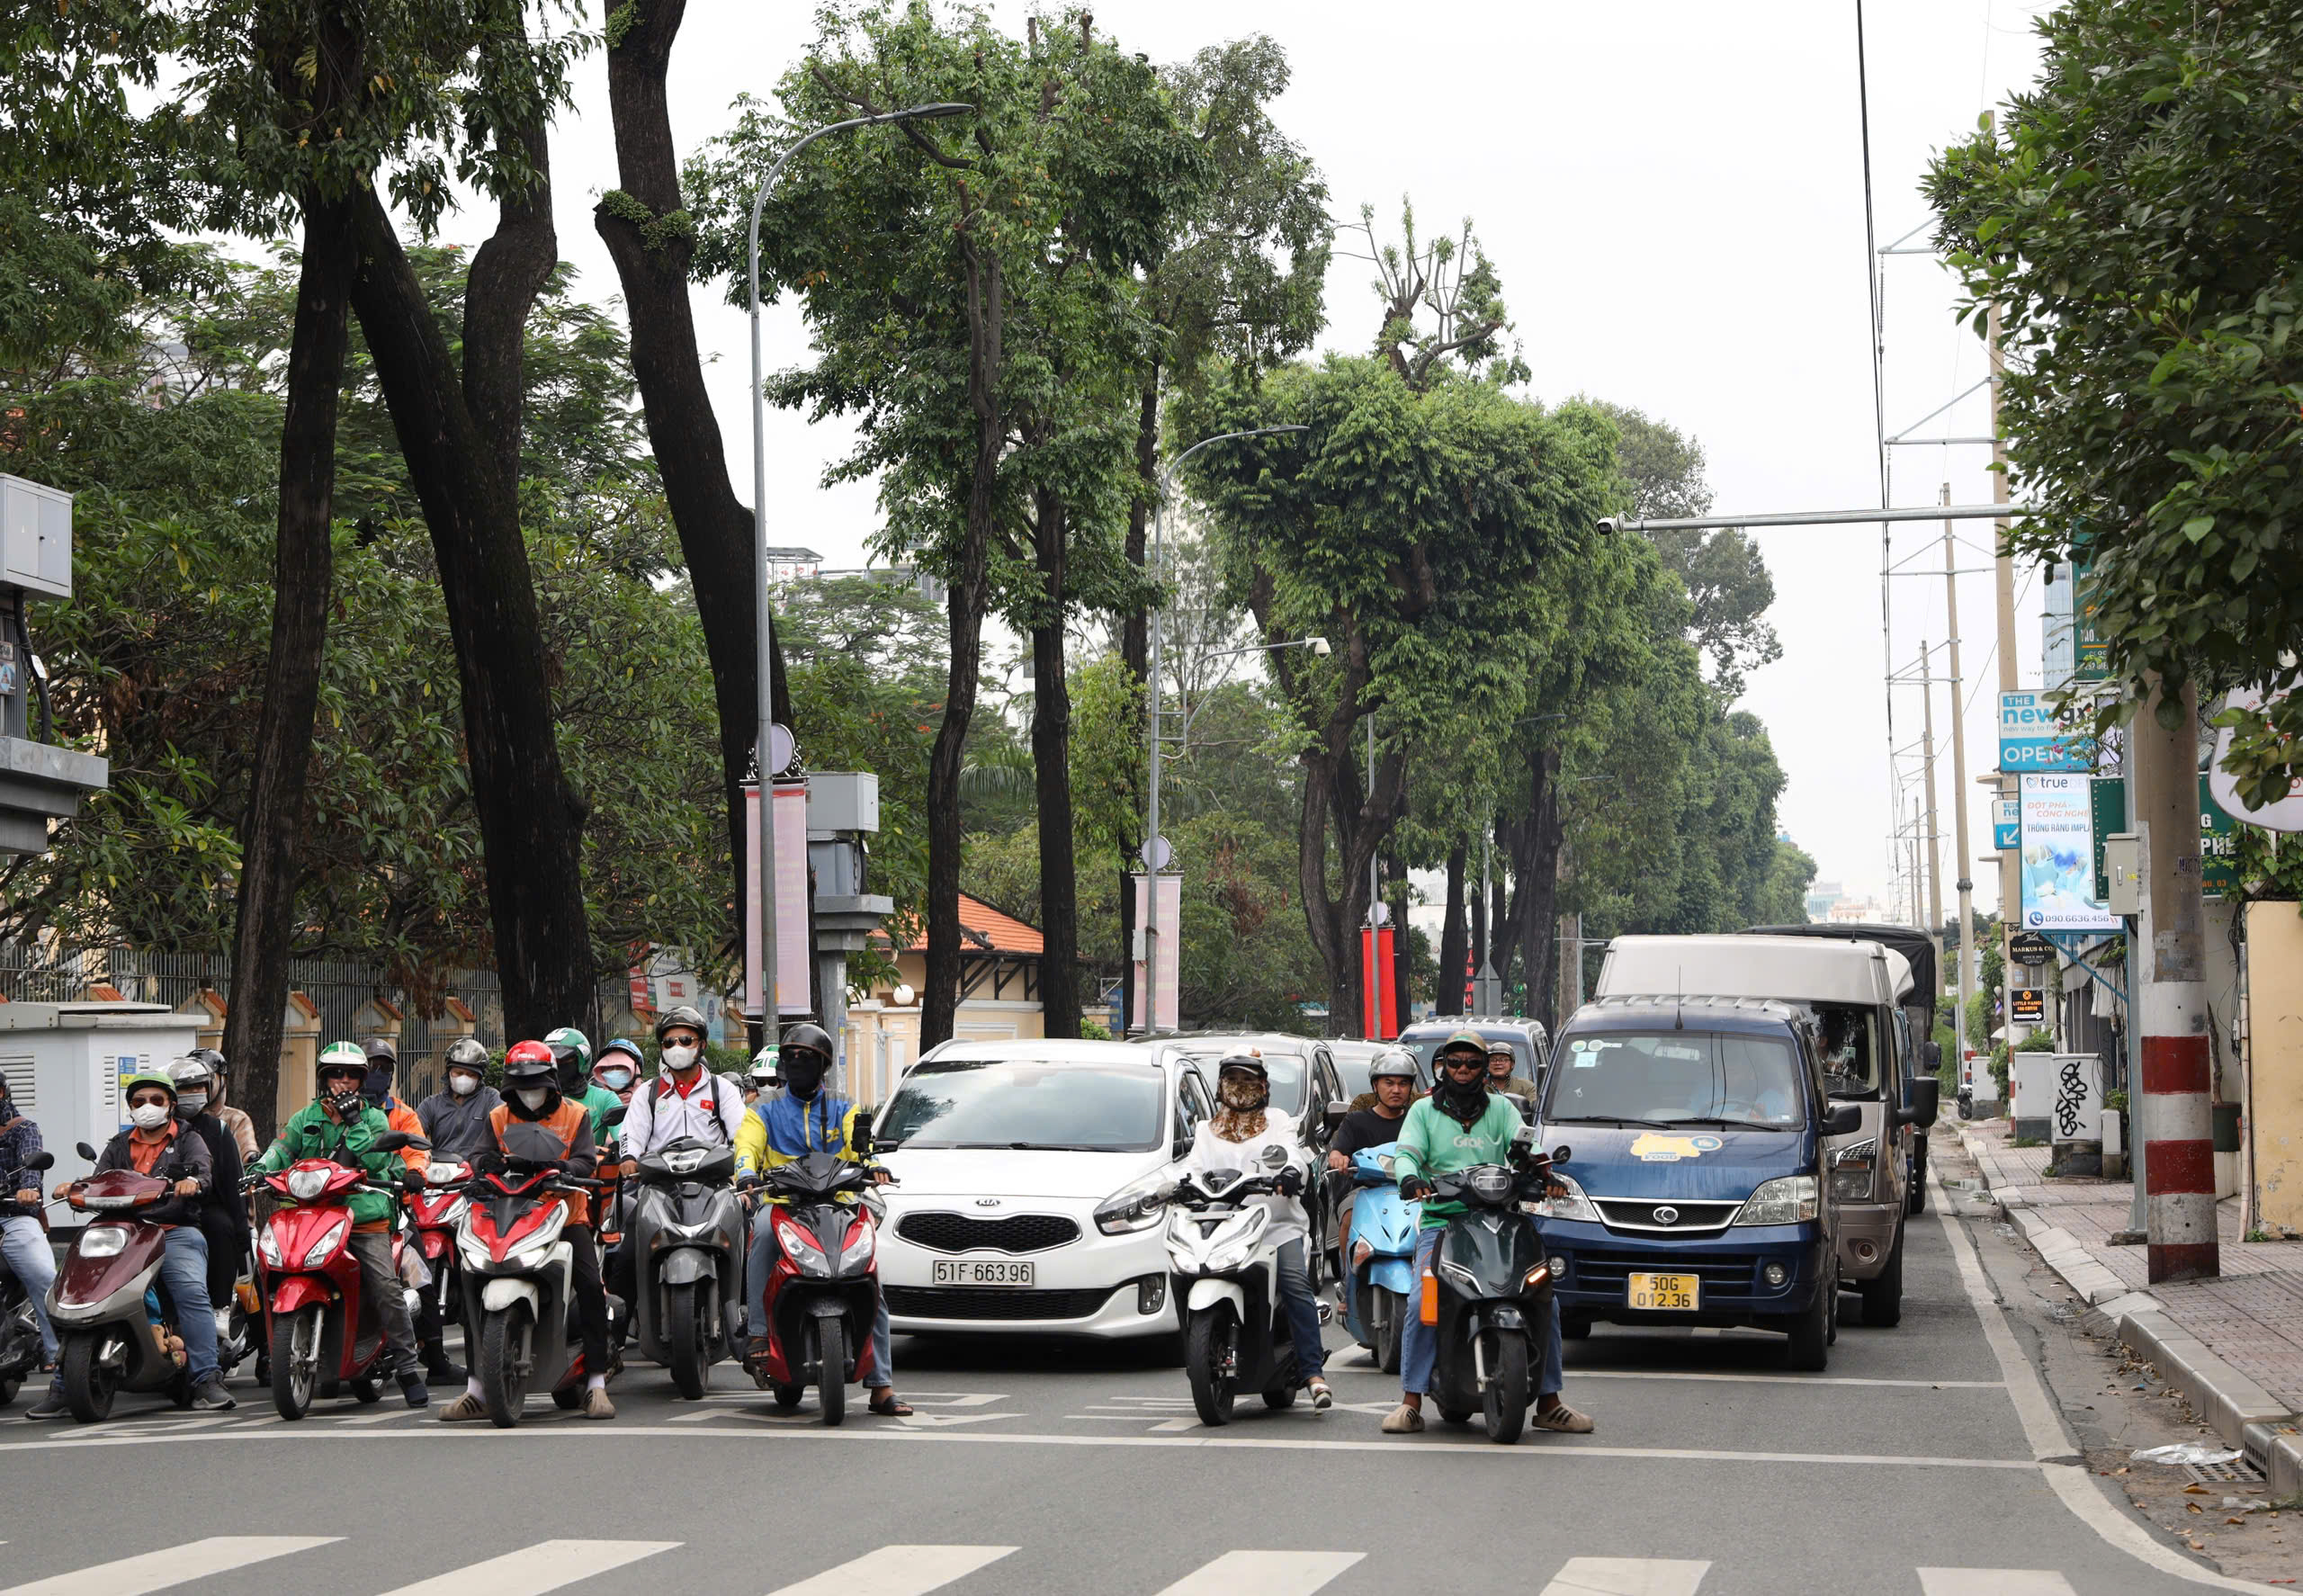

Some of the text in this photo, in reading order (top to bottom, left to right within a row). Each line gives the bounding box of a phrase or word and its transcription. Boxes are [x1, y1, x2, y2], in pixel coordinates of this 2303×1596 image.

[2008, 696, 2030, 705] THE
[937, 1262, 1029, 1282] 51F-663.96
[1650, 1277, 1679, 1291] 50G
[1636, 1292, 1690, 1307] 012.36
